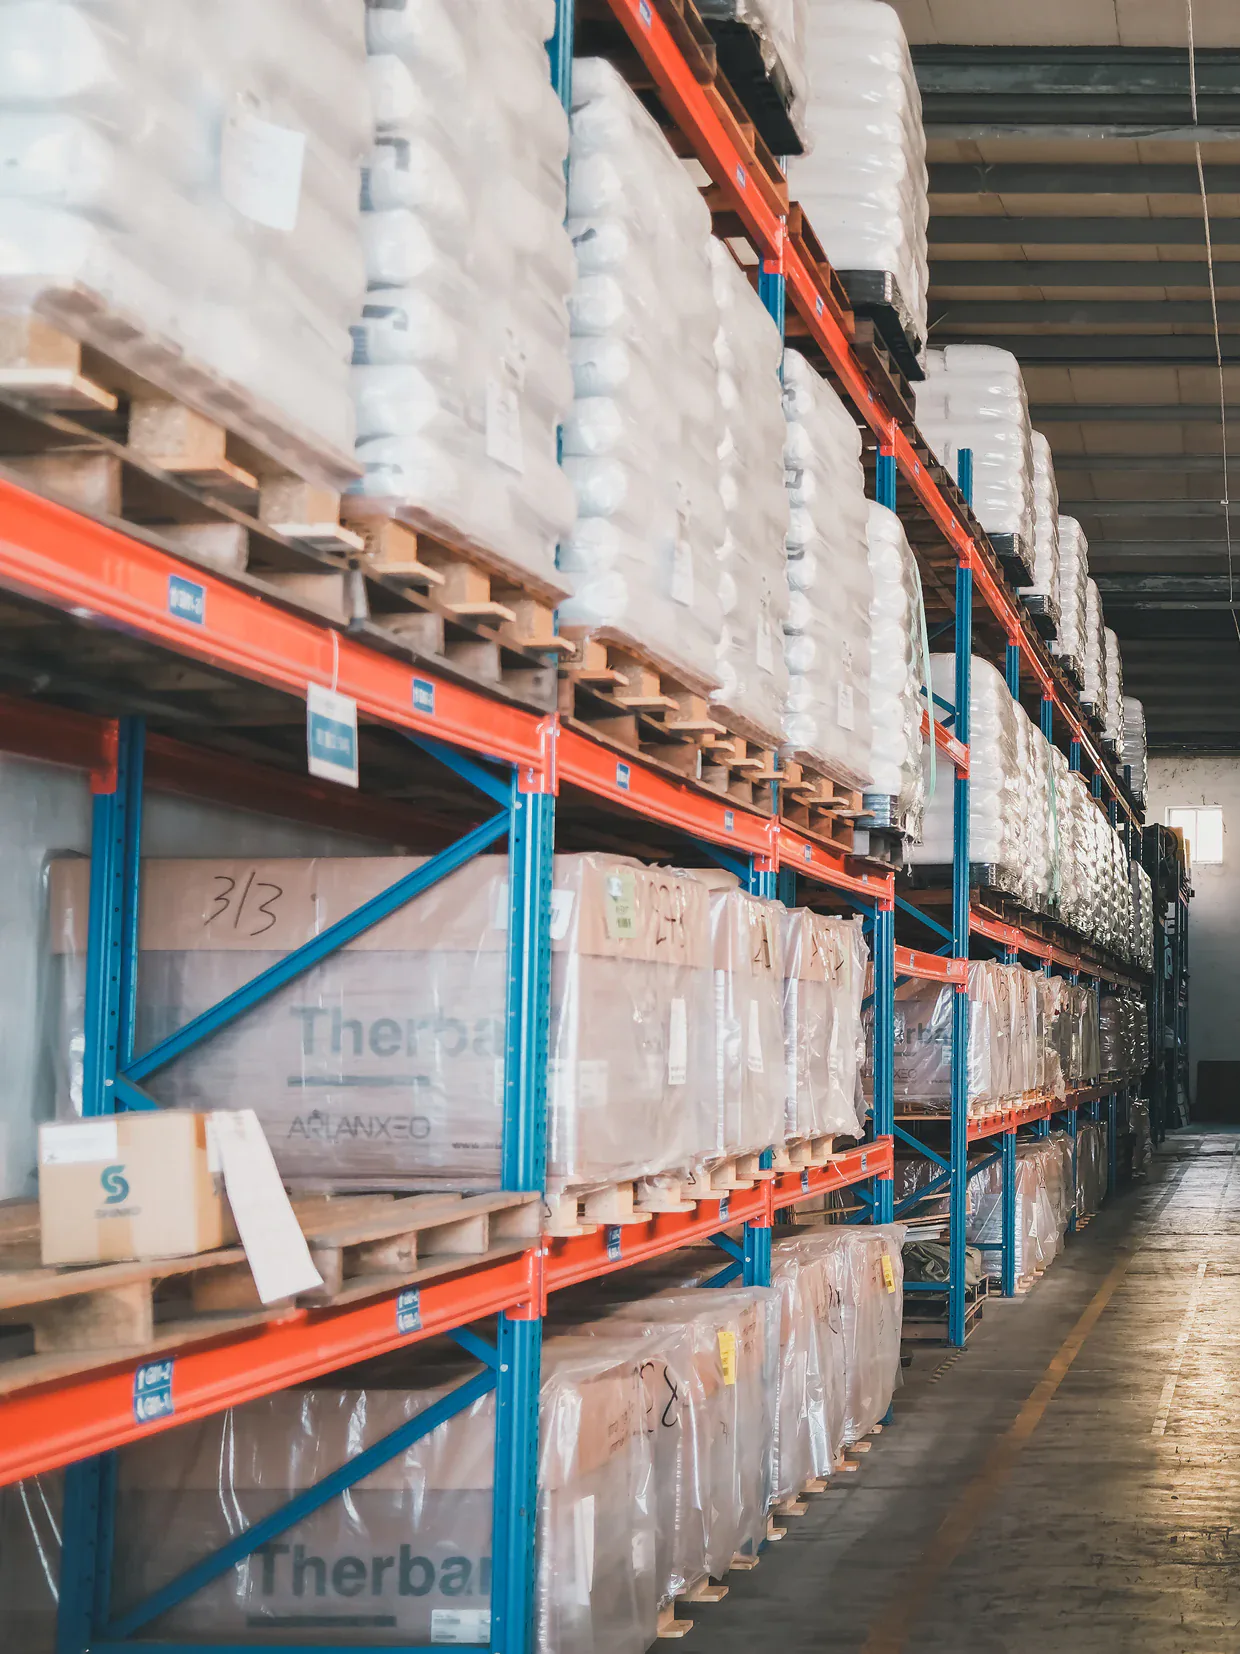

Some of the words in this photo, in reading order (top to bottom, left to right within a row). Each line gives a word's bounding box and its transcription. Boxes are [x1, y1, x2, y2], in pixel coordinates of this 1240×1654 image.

[204, 871, 283, 936] 3/3
[289, 1005, 505, 1058] Therba
[287, 1109, 431, 1140] ARLANXEO
